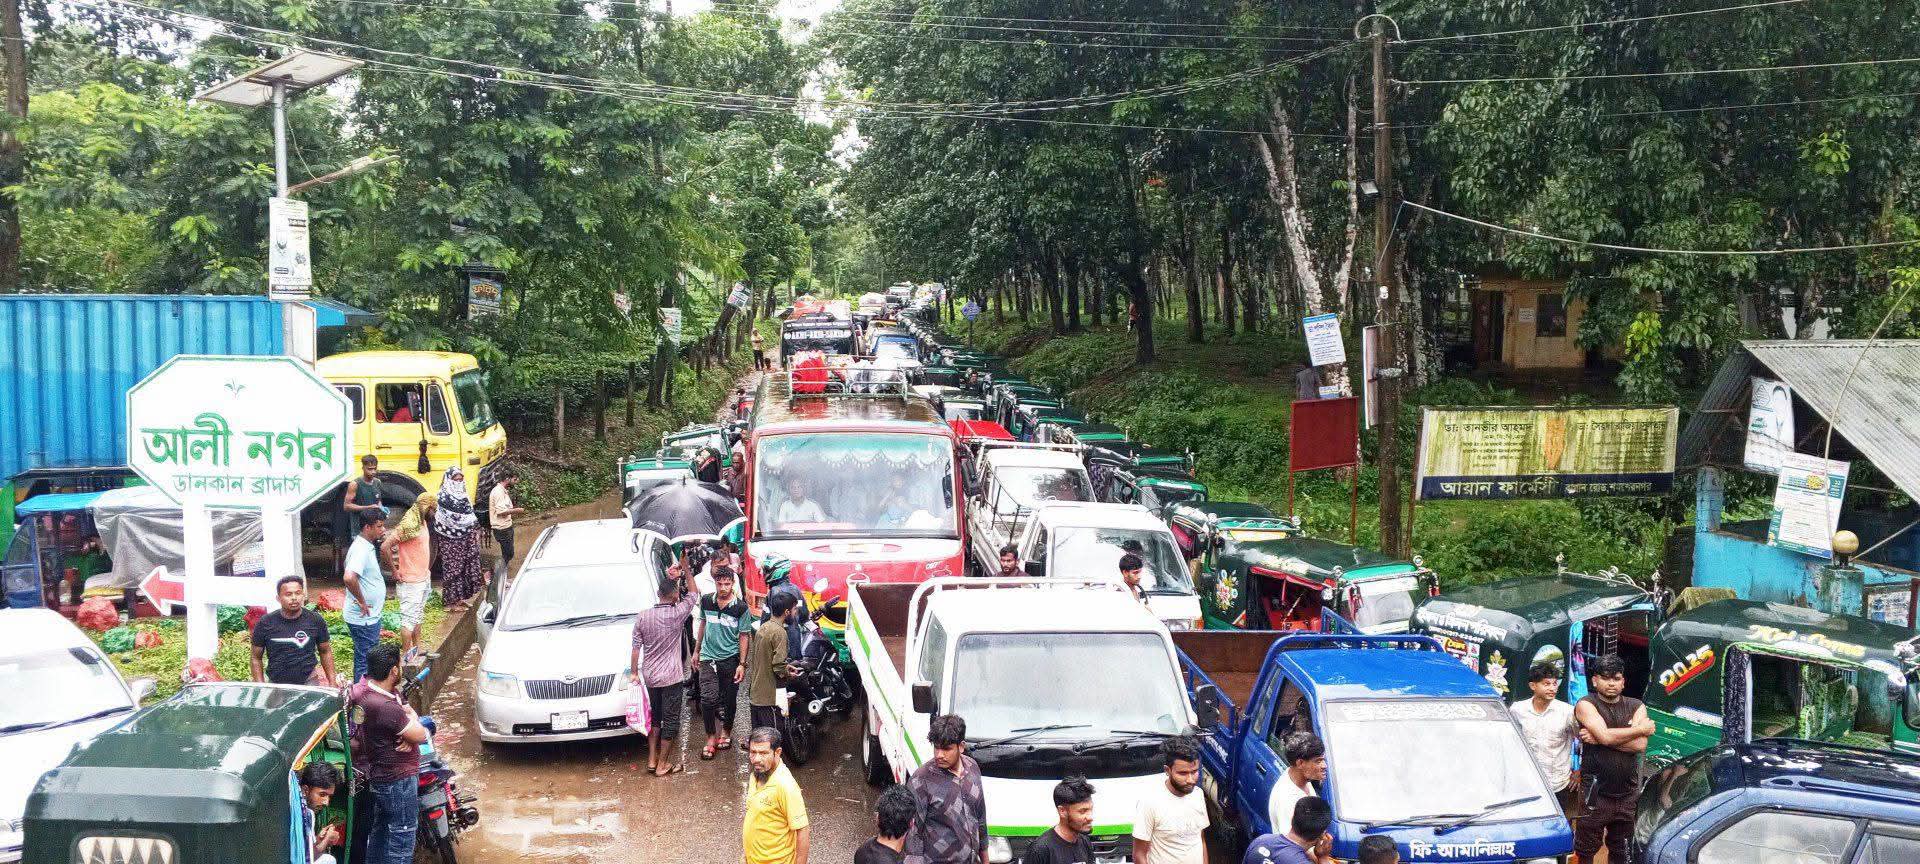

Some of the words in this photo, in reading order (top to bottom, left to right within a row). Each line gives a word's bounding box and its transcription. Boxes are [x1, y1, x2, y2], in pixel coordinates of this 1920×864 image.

[139, 412, 234, 467] আলী
[243, 427, 336, 471] নগর
[172, 473, 245, 493] ডানকান
[249, 473, 303, 496] ব্রাদার্স
